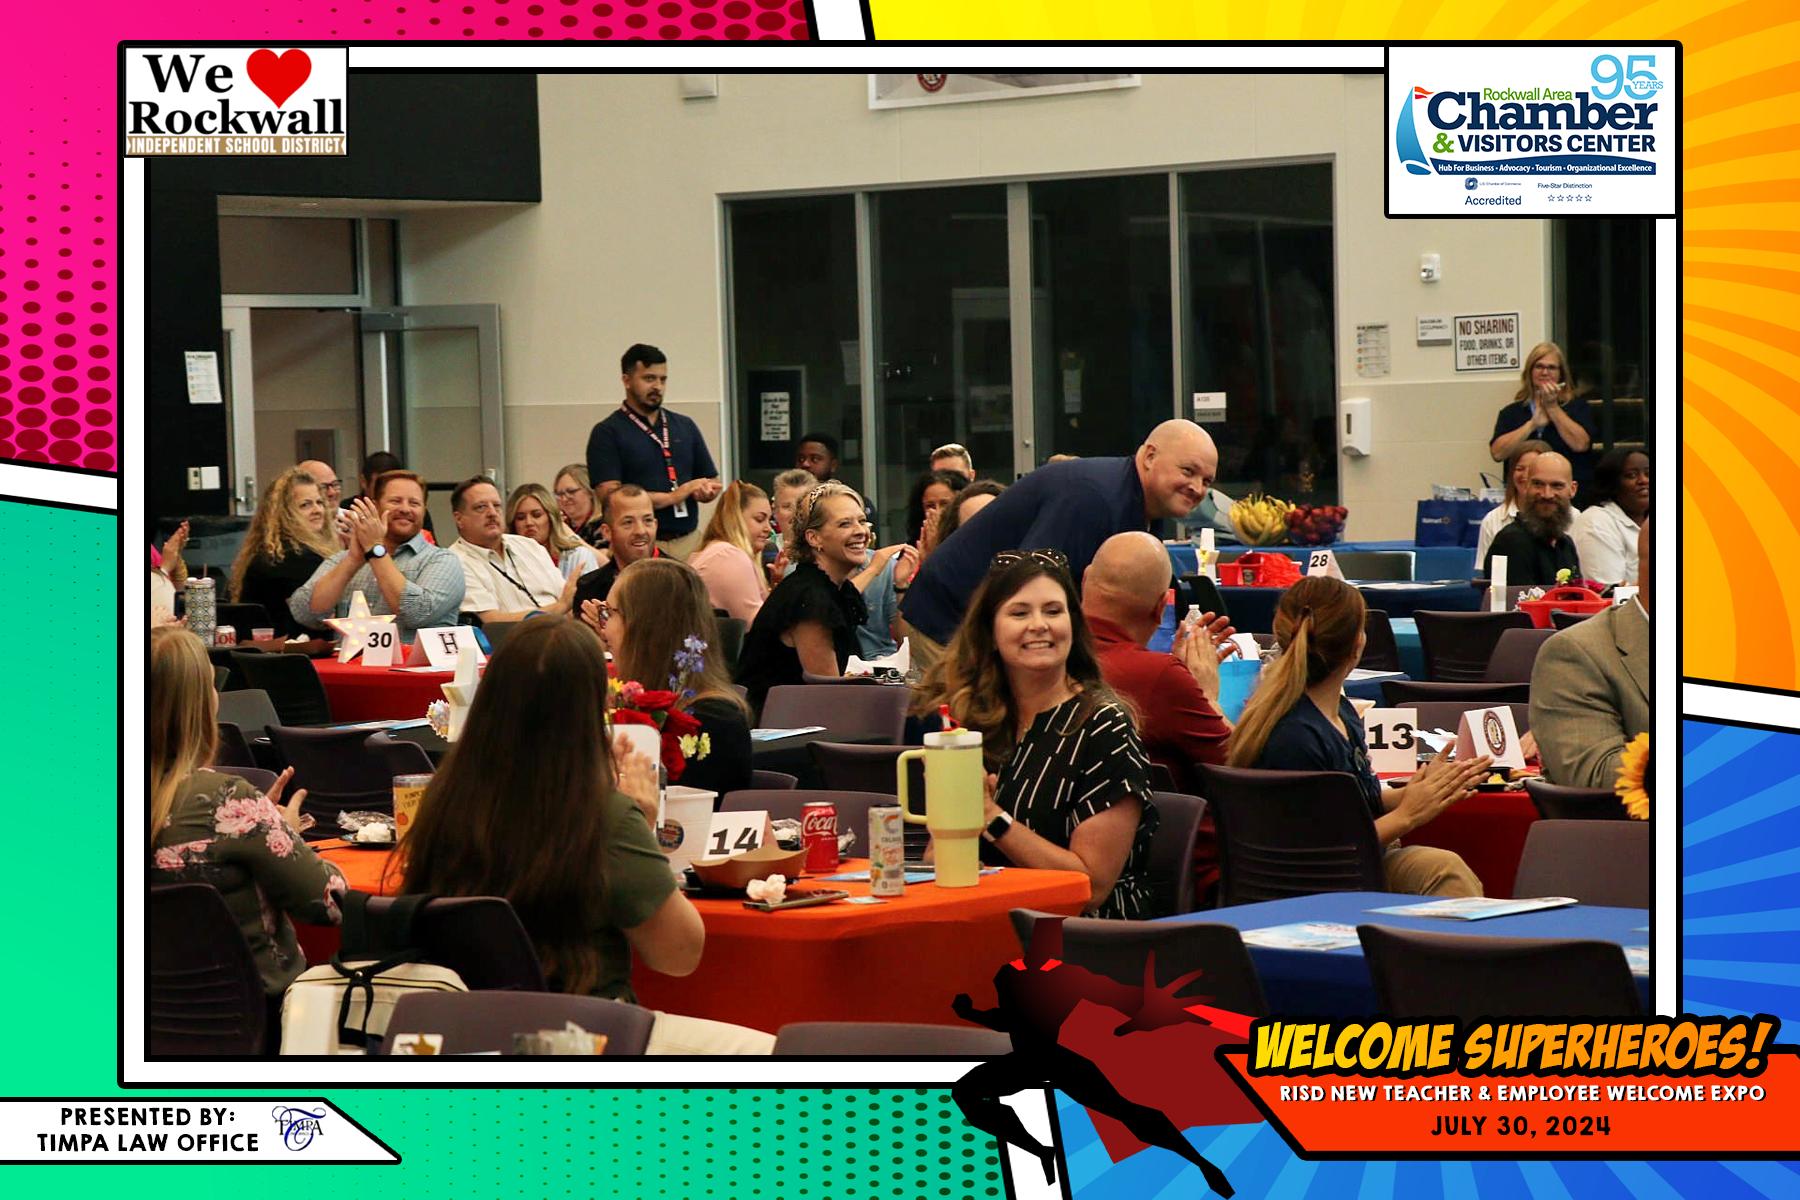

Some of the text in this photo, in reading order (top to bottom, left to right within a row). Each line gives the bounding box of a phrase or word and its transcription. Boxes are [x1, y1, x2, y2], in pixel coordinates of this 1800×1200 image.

[1459, 318, 1514, 336] NO SHARING
[1459, 340, 1478, 351] FOOD,
[1505, 338, 1514, 348] OR
[1467, 354, 1508, 366] OTHER ITEMS
[1310, 554, 1328, 568] 28
[367, 631, 393, 649] 30
[438, 632, 459, 654] H
[1368, 722, 1415, 750] 13
[708, 826, 758, 855] 14
